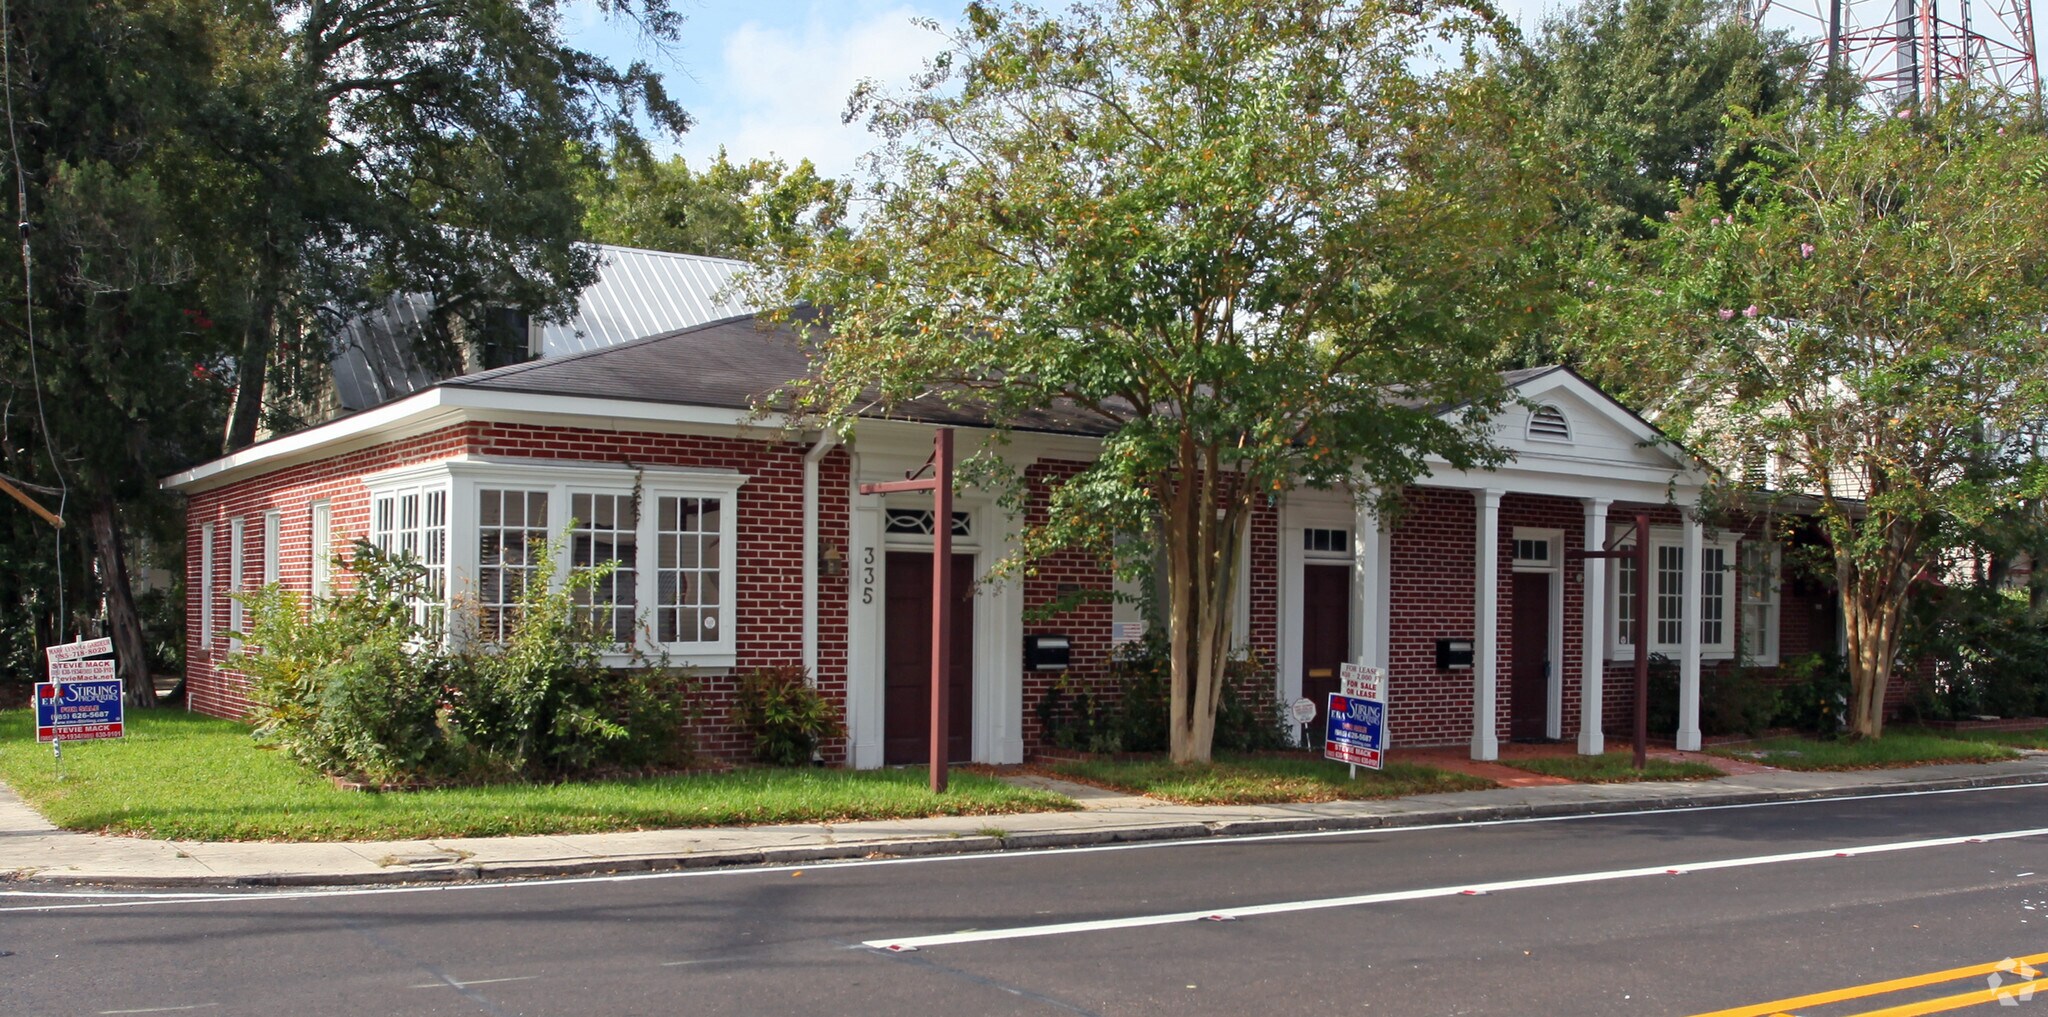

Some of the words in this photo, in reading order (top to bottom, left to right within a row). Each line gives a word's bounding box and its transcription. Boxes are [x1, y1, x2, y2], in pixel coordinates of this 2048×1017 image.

[862, 547, 875, 604] 335
[55, 646, 107, 659] 985-718-8020
[52, 674, 114, 682] evieMack.net
[1346, 680, 1358, 688] FOR
[1360, 682, 1377, 691] SALE
[1356, 690, 1377, 699] LEASE
[71, 711, 109, 719] 626-5687
